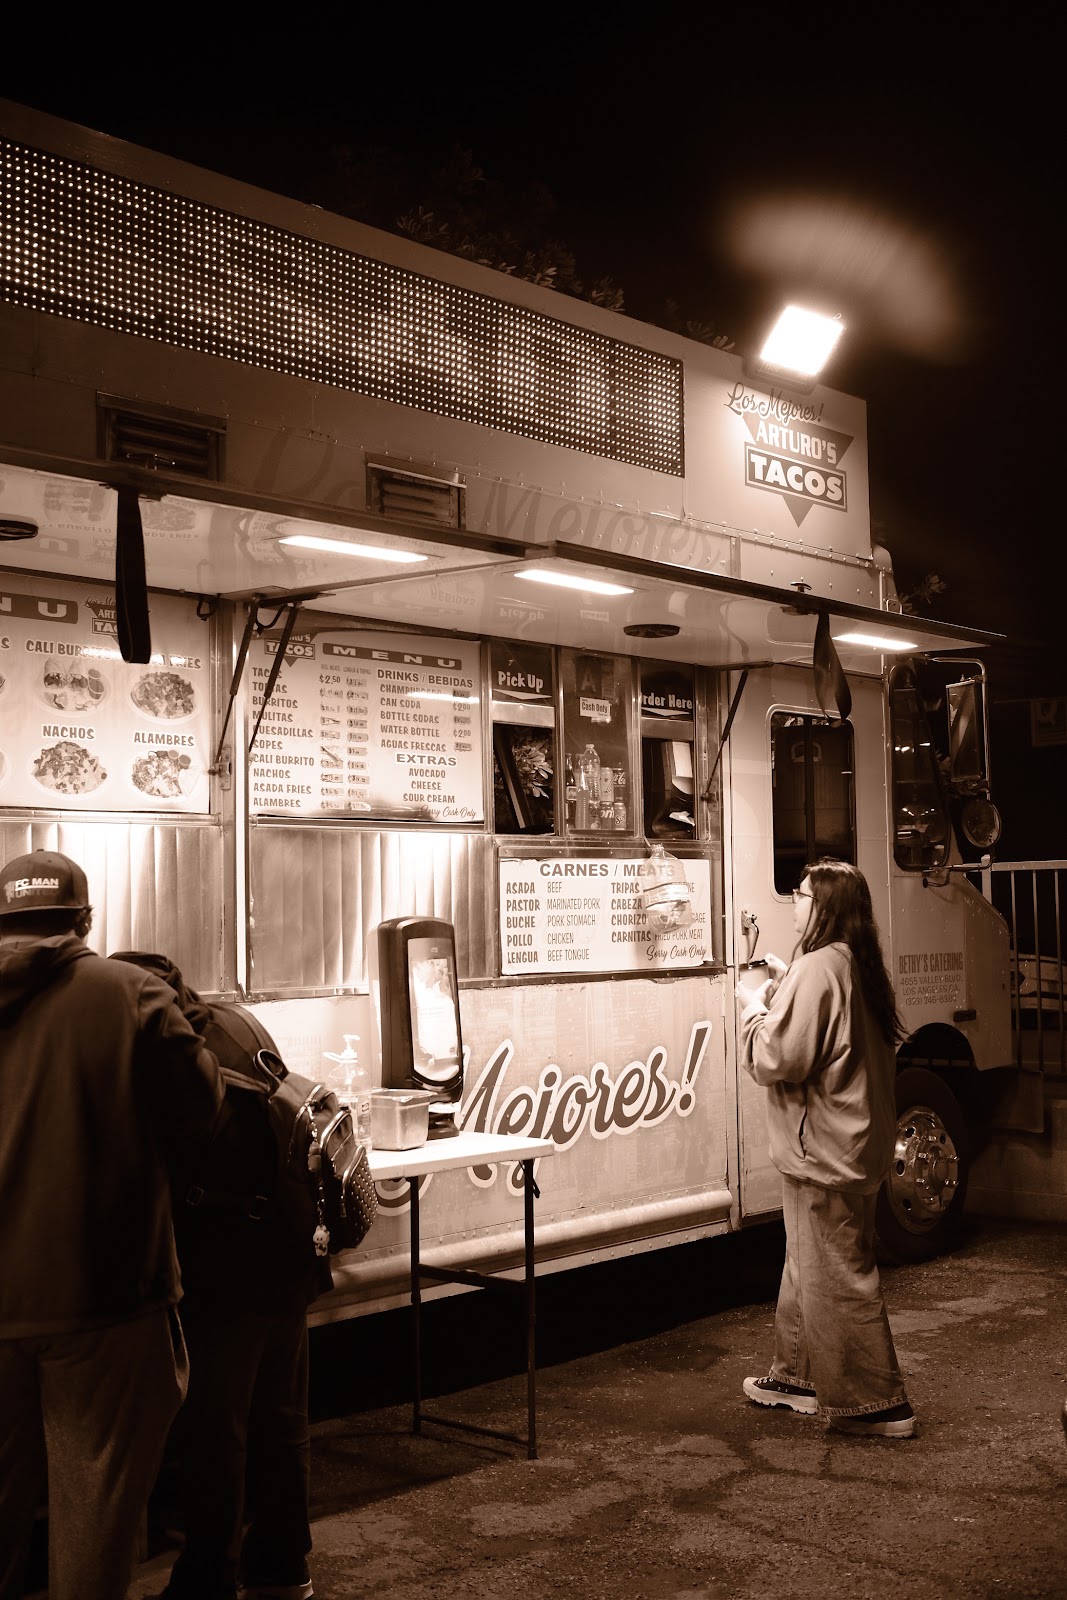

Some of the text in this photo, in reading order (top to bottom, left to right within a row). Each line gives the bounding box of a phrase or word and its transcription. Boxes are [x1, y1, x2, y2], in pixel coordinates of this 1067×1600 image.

[724, 382, 824, 423] Los Mejores!
[756, 421, 837, 464] ARTURO'S
[751, 453, 843, 501] TACOS
[26, 640, 53, 653] CALI
[252, 667, 282, 679] TACS
[378, 669, 419, 682] DRINKS
[428, 675, 473, 688] BEBIDAS
[252, 682, 288, 693] TOAS
[498, 670, 544, 693] Pick Up
[252, 696, 298, 708] BURRITOS
[380, 698, 396, 707] CAN
[400, 699, 421, 709] SODA
[582, 702, 608, 714] Cash Only
[668, 694, 692, 709] Here
[252, 710, 293, 722] MULITAS
[380, 710, 440, 724] BOTTLE SODAS
[43, 725, 95, 740] NACHOS
[380, 724, 408, 734] WATER
[411, 727, 440, 738] BOTTLE
[134, 732, 195, 747] ALAMBRES
[253, 740, 282, 750] SOPES
[381, 739, 408, 750] AGUAS
[410, 742, 446, 752] FRESCAS
[254, 754, 272, 764] CALI
[276, 755, 314, 766] BURRITO
[396, 754, 456, 766] EXTRAS
[254, 768, 290, 778] NACHOS
[409, 768, 446, 778] AVOCADO
[254, 782, 284, 792] ASADA
[286, 784, 312, 794] FRIES
[411, 781, 442, 790] CHEESE
[254, 798, 301, 808] ALAMBRES
[403, 793, 455, 803] SOUR CREAM
[460, 807, 476, 820] Only
[540, 864, 608, 877] CARNES
[623, 864, 676, 877] MEATS
[16, 878, 29, 888] FC
[506, 882, 536, 894] ASADA
[548, 882, 562, 894] BEEF
[611, 882, 640, 894] TRIPAS
[506, 898, 642, 912] PASTOR MARINATED PORK CABEZA
[506, 916, 536, 928] BUCHE
[548, 915, 565, 926] PORK
[566, 914, 596, 926] STOMACH
[612, 914, 646, 926] CHORIZO
[507, 934, 532, 946] POLLO
[548, 932, 574, 944] CHICKEN
[612, 930, 652, 943] CARNITAS
[689, 929, 703, 940] MEAT
[507, 949, 590, 964] LENGUA BEEF TONGUE
[646, 944, 707, 961] Sorry Cash Only
[899, 952, 963, 974] BETHY'S CATERING
[919, 976, 942, 984] VALLEY
[902, 987, 916, 996] LOS
